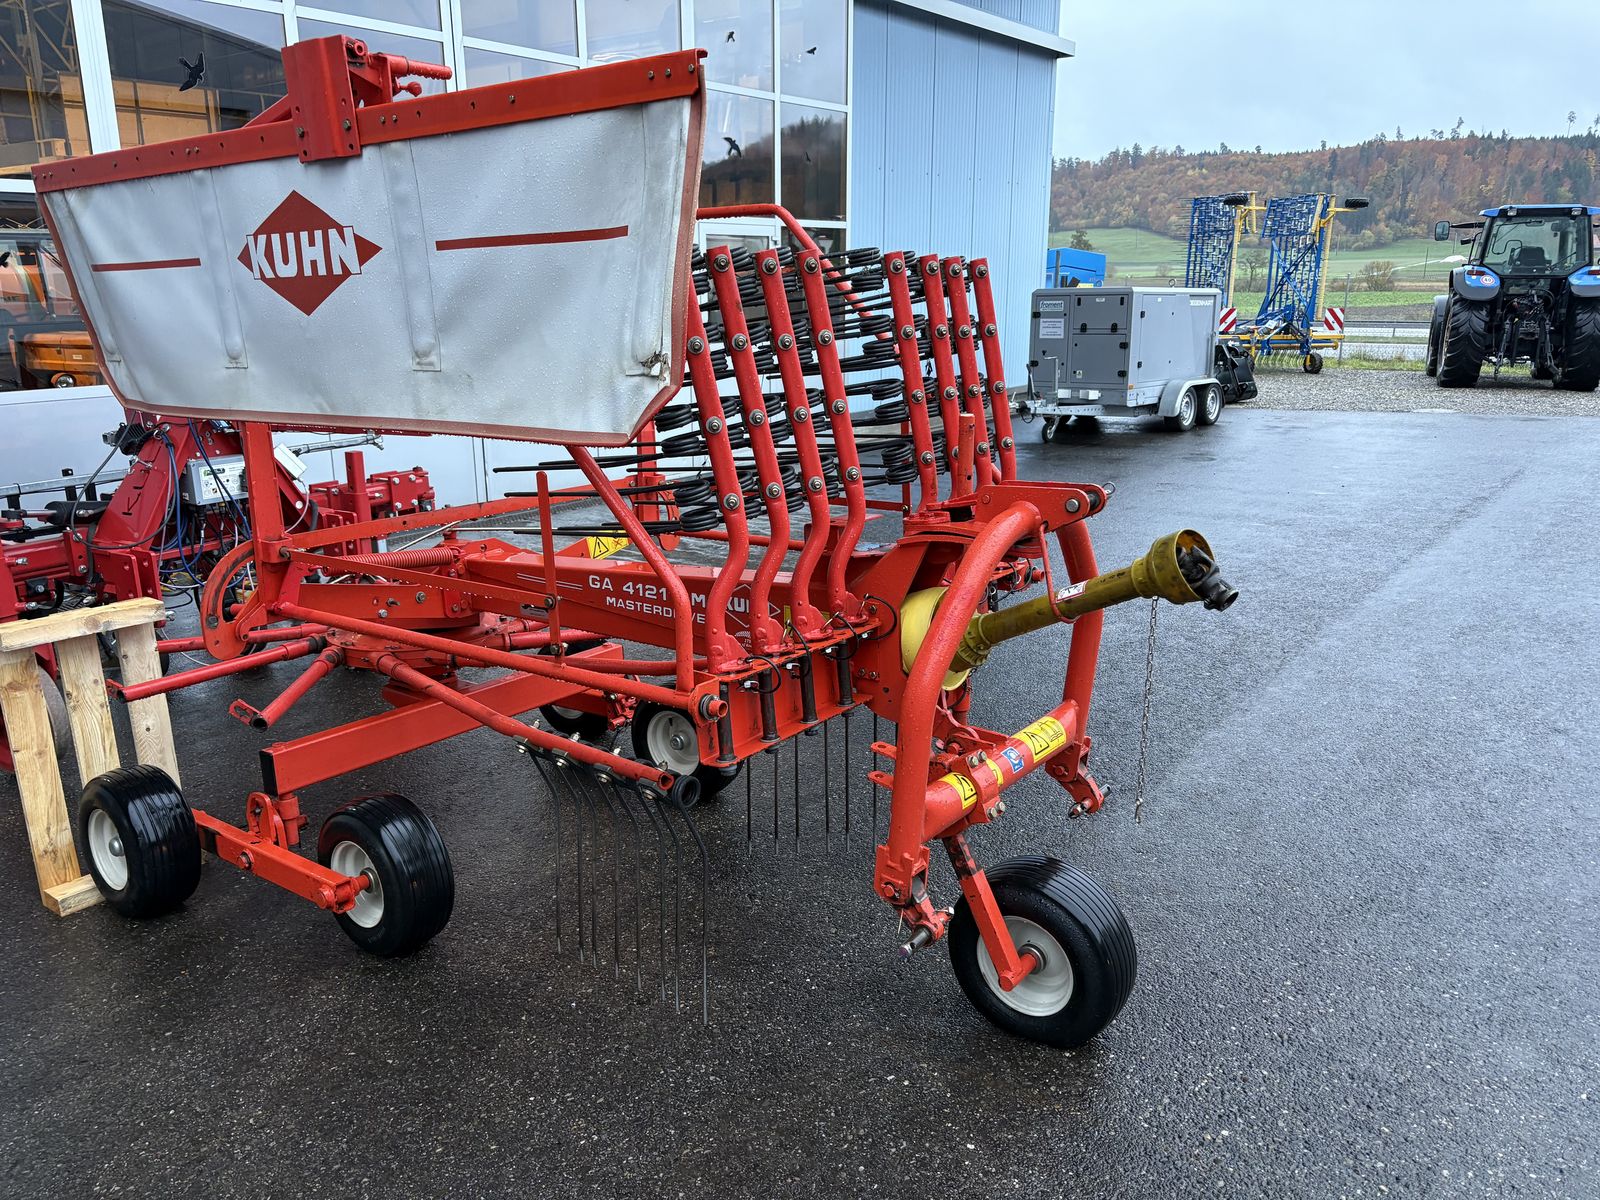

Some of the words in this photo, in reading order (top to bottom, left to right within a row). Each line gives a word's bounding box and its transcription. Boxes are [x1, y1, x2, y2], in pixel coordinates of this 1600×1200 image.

[246, 226, 362, 280] KUHN
[589, 575, 613, 592] GA
[622, 581, 667, 601] 4121
[691, 592, 706, 608] M
